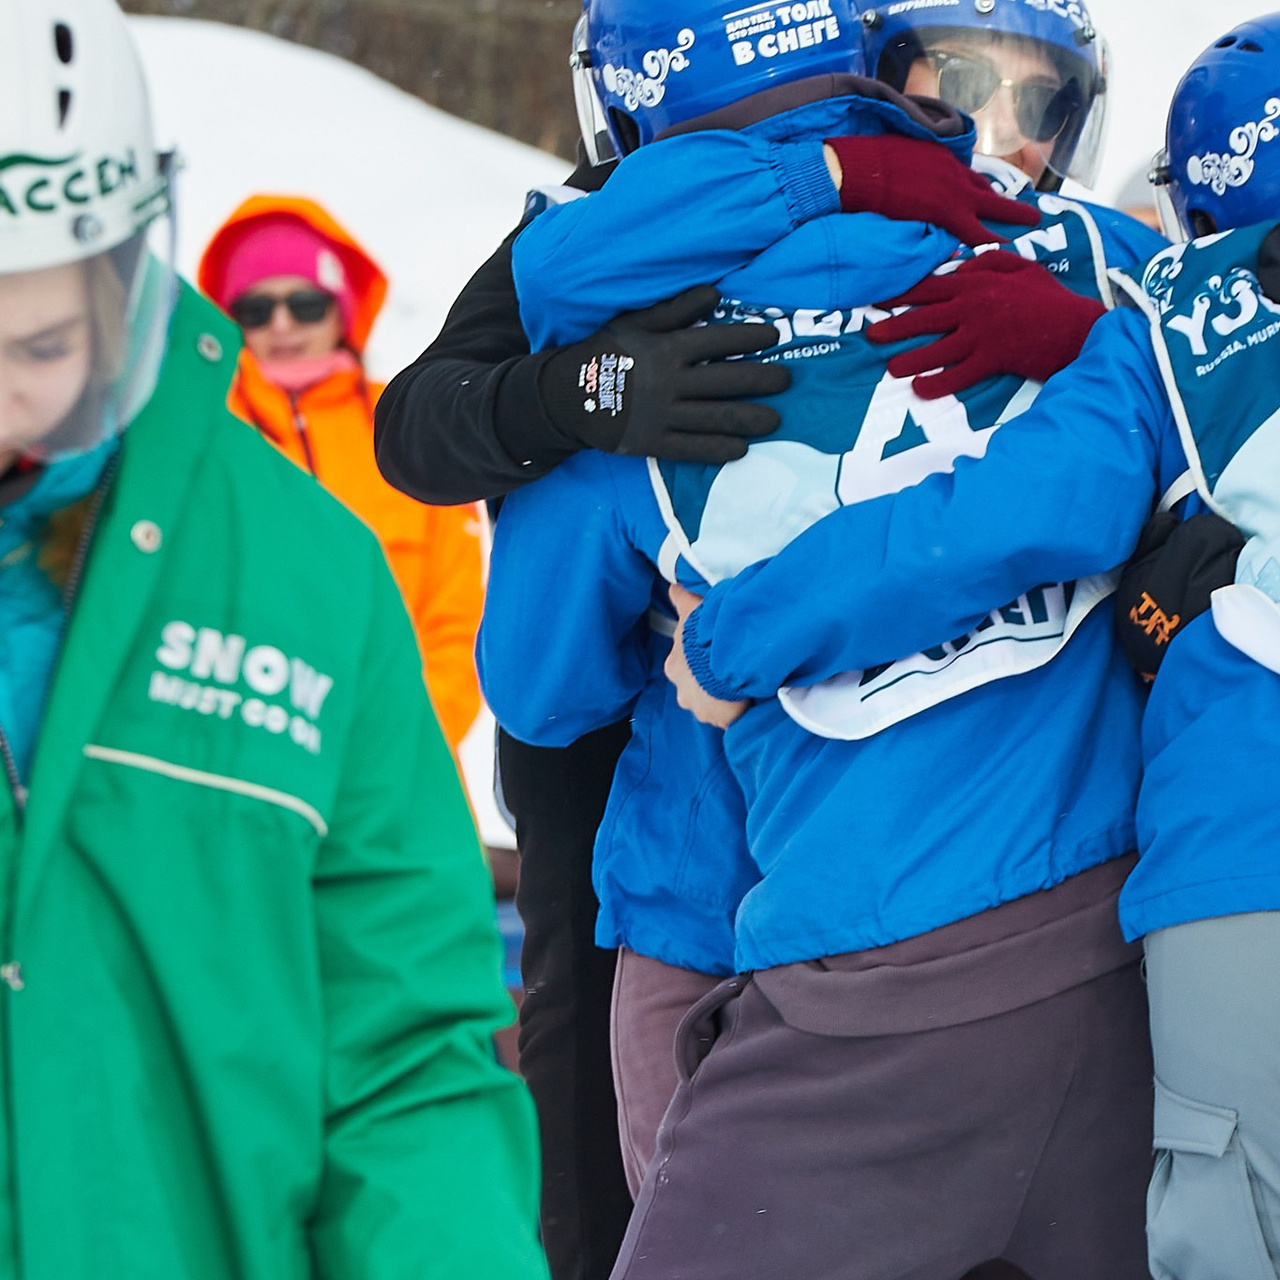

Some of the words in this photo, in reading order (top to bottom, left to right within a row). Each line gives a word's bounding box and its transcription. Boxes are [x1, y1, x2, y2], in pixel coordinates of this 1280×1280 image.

[732, 40, 756, 66] В
[758, 16, 840, 58] СНЕГЕ
[783, 341, 841, 361] REGION
[155, 620, 335, 721] SNOW
[148, 669, 243, 720] MUST
[240, 697, 290, 734] GO
